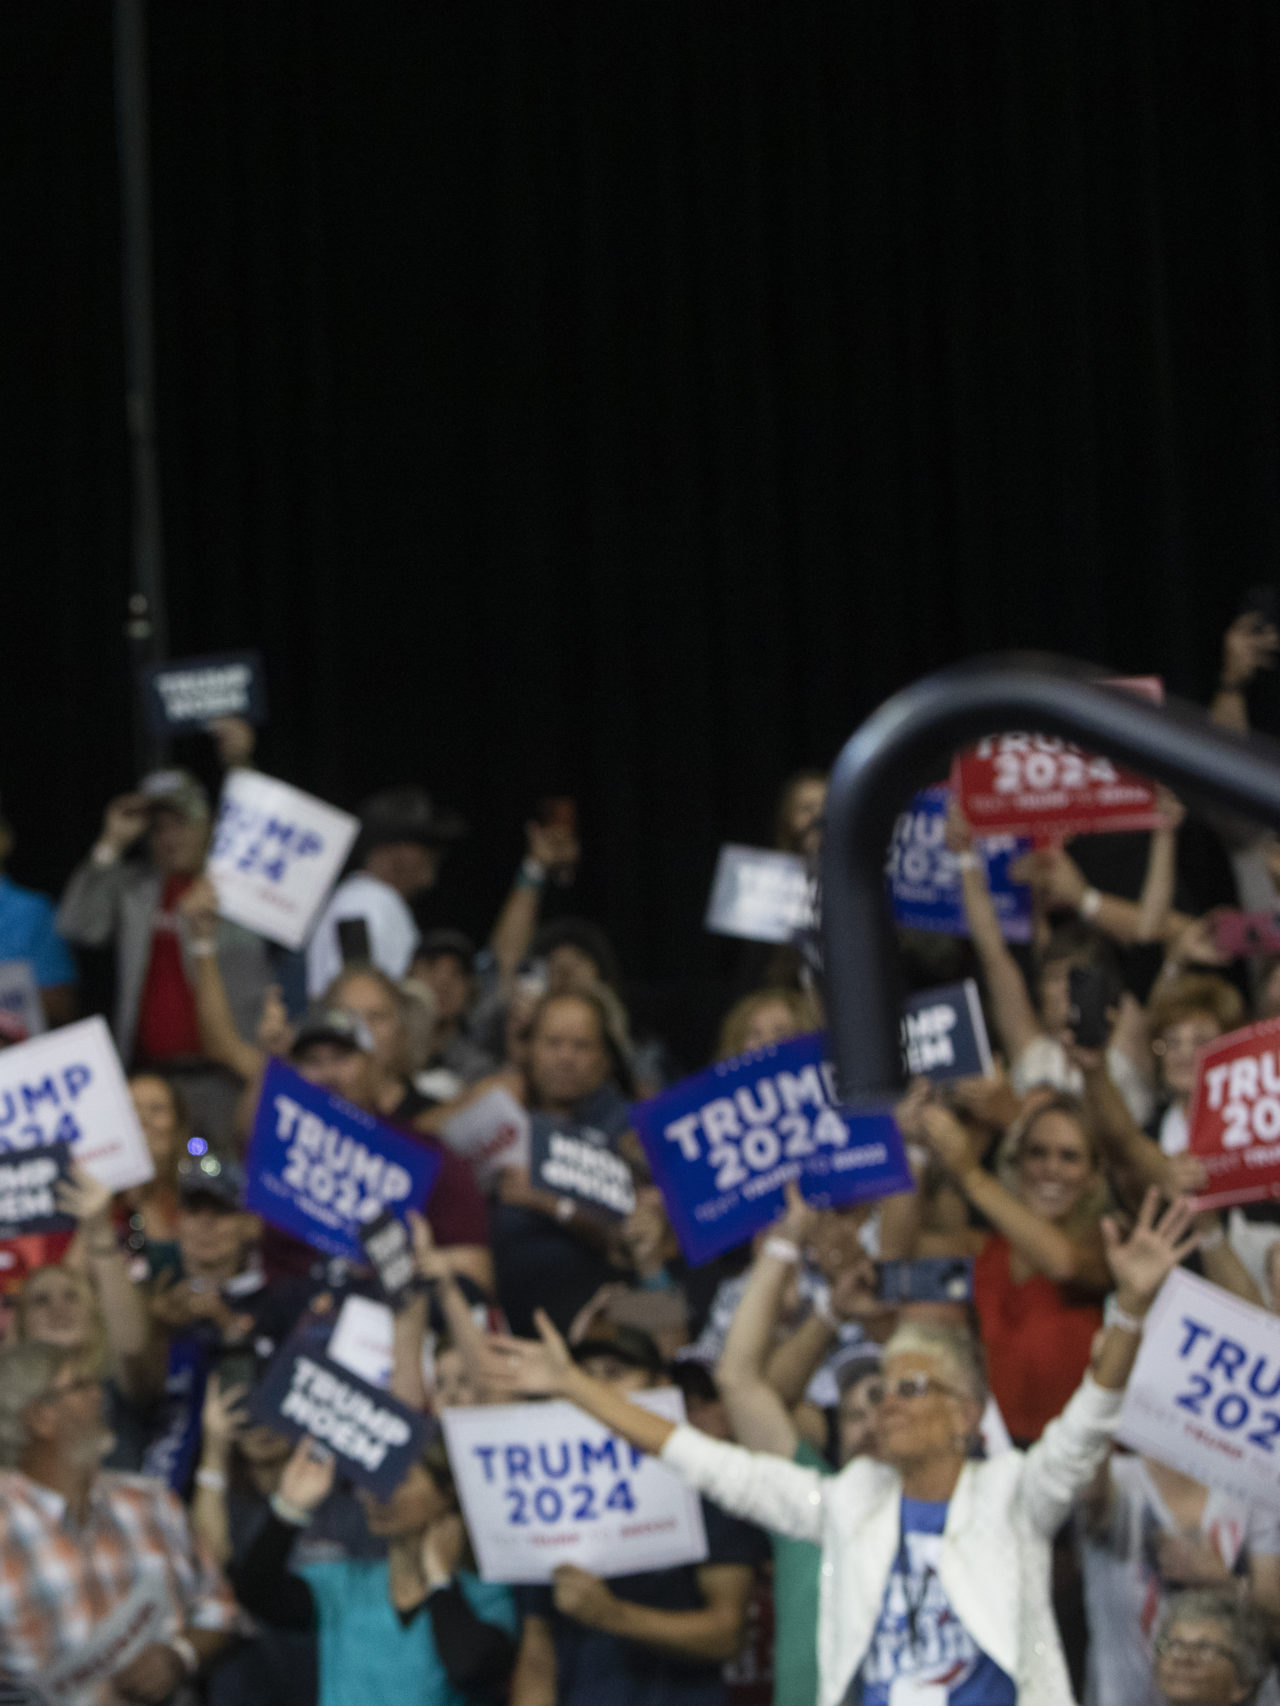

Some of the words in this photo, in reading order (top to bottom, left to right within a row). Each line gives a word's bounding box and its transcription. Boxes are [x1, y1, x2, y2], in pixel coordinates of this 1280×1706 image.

[273, 1093, 412, 1201] TRUMP
[707, 1108, 849, 1190] 2024
[279, 1391, 390, 1473] NOEM
[293, 1356, 412, 1447] TRUMP
[505, 1478, 637, 1527] 2024
